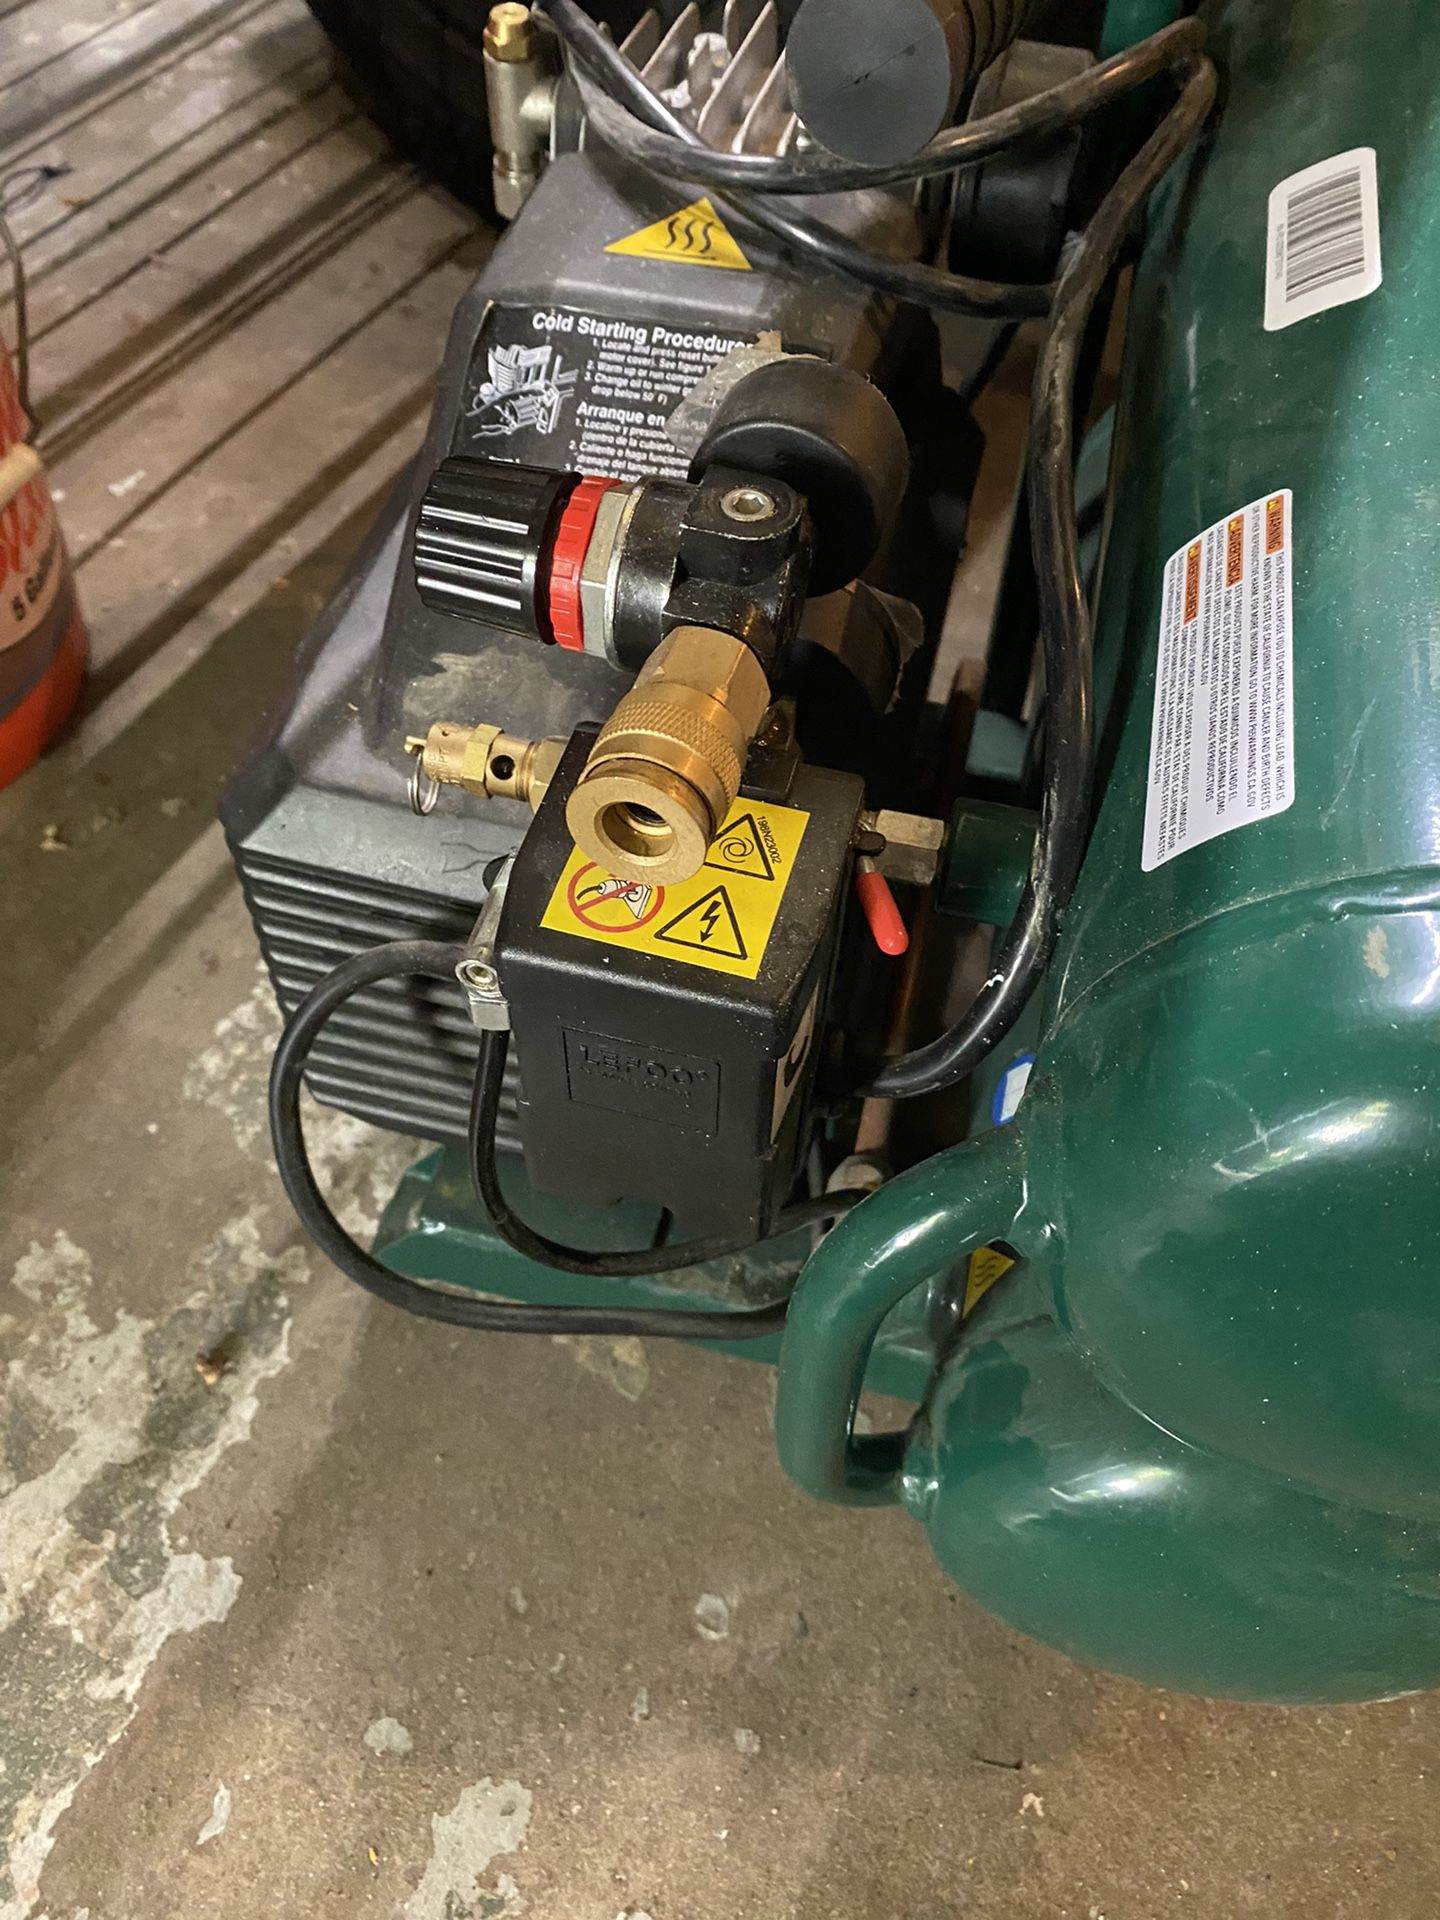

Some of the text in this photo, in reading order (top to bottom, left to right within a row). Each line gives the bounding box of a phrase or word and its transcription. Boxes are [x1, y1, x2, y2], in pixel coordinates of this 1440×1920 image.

[532, 312, 574, 332] Cold
[577, 316, 647, 345] Starting
[601, 339, 631, 352] Locate
[632, 343, 650, 354] and
[651, 346, 676, 358] press
[677, 349, 700, 361] reset
[596, 362, 623, 373] Warm
[648, 370, 664, 379] run
[664, 372, 702, 387] compre
[658, 358, 676, 369] See
[676, 361, 704, 375] figure
[593, 372, 628, 387] Change
[590, 384, 613, 396] drop
[614, 388, 640, 399] below
[575, 400, 644, 426] Arranque
[646, 413, 665, 426] en
[583, 419, 621, 433] Localice
[610, 459, 625, 469] del
[626, 462, 658, 474] tanque
[624, 449, 647, 461] haga
[1269, 509, 1280, 548] WARNING
[1228, 528, 1240, 584] ADVERTENCIA
[1275, 552, 1283, 566] THIS
[1185, 556, 1199, 620] AVERTISSEMENT
[1234, 584, 1242, 599] ESTE
[1275, 566, 1283, 595] PRODUCT
[1213, 598, 1221, 628] DEFECTOS
[1250, 597, 1258, 611] FOR
[1275, 595, 1283, 609] CAN
[1233, 600, 1241, 634] PRODUCTO
[1275, 610, 1284, 634] EXPOSE
[1212, 628, 1219, 638] DE
[1222, 627, 1230, 642] SON
[1232, 634, 1240, 655] PUEDE
[1275, 636, 1284, 650] YOU
[1210, 638, 1219, 683] NACIMIENTOS
[1221, 642, 1229, 681] CONOCIDOS
[1249, 630, 1257, 677] INFORMATION
[1275, 650, 1284, 660] TO
[1231, 656, 1240, 696] EXPONERLO
[1248, 678, 1257, 689] GO
[1261, 557, 1271, 810] KNOWN TO THE STATE OF CALIFORNIA TO CAUSE CANCER AND BIRTH DEFECTS
[1275, 660, 1284, 700] CHEMICALS
[1185, 689, 1193, 709] VOUS
[1220, 681, 1228, 697] POR
[1248, 690, 1256, 699] TO
[1209, 690, 1217, 714] OTROS
[1220, 697, 1228, 705] EL
[1165, 707, 1173, 746] NAISSANCE
[1183, 709, 1192, 740] EXPOSER
[1219, 705, 1227, 734] ESTADO
[1275, 701, 1284, 740] INCLUDING
[1173, 734, 1181, 748] PAR
[1218, 735, 1227, 745] DE
[1182, 748, 1190, 762] DES
[1171, 773, 1179, 784] DE
[1217, 745, 1226, 789] CALIFORNIA
[1275, 764, 1284, 790] WHICH
[1180, 763, 1189, 795] PRODUIT
[1160, 794, 1168, 819] EFFETS
[1168, 784, 1178, 827] CALIFORNIE
[1216, 790, 1225, 814] COMO
[1228, 792, 1237, 800] EL
[1275, 791, 1285, 800] IS
[1178, 796, 1188, 839] CHIMIQUES
[1167, 828, 1175, 850] POUR
